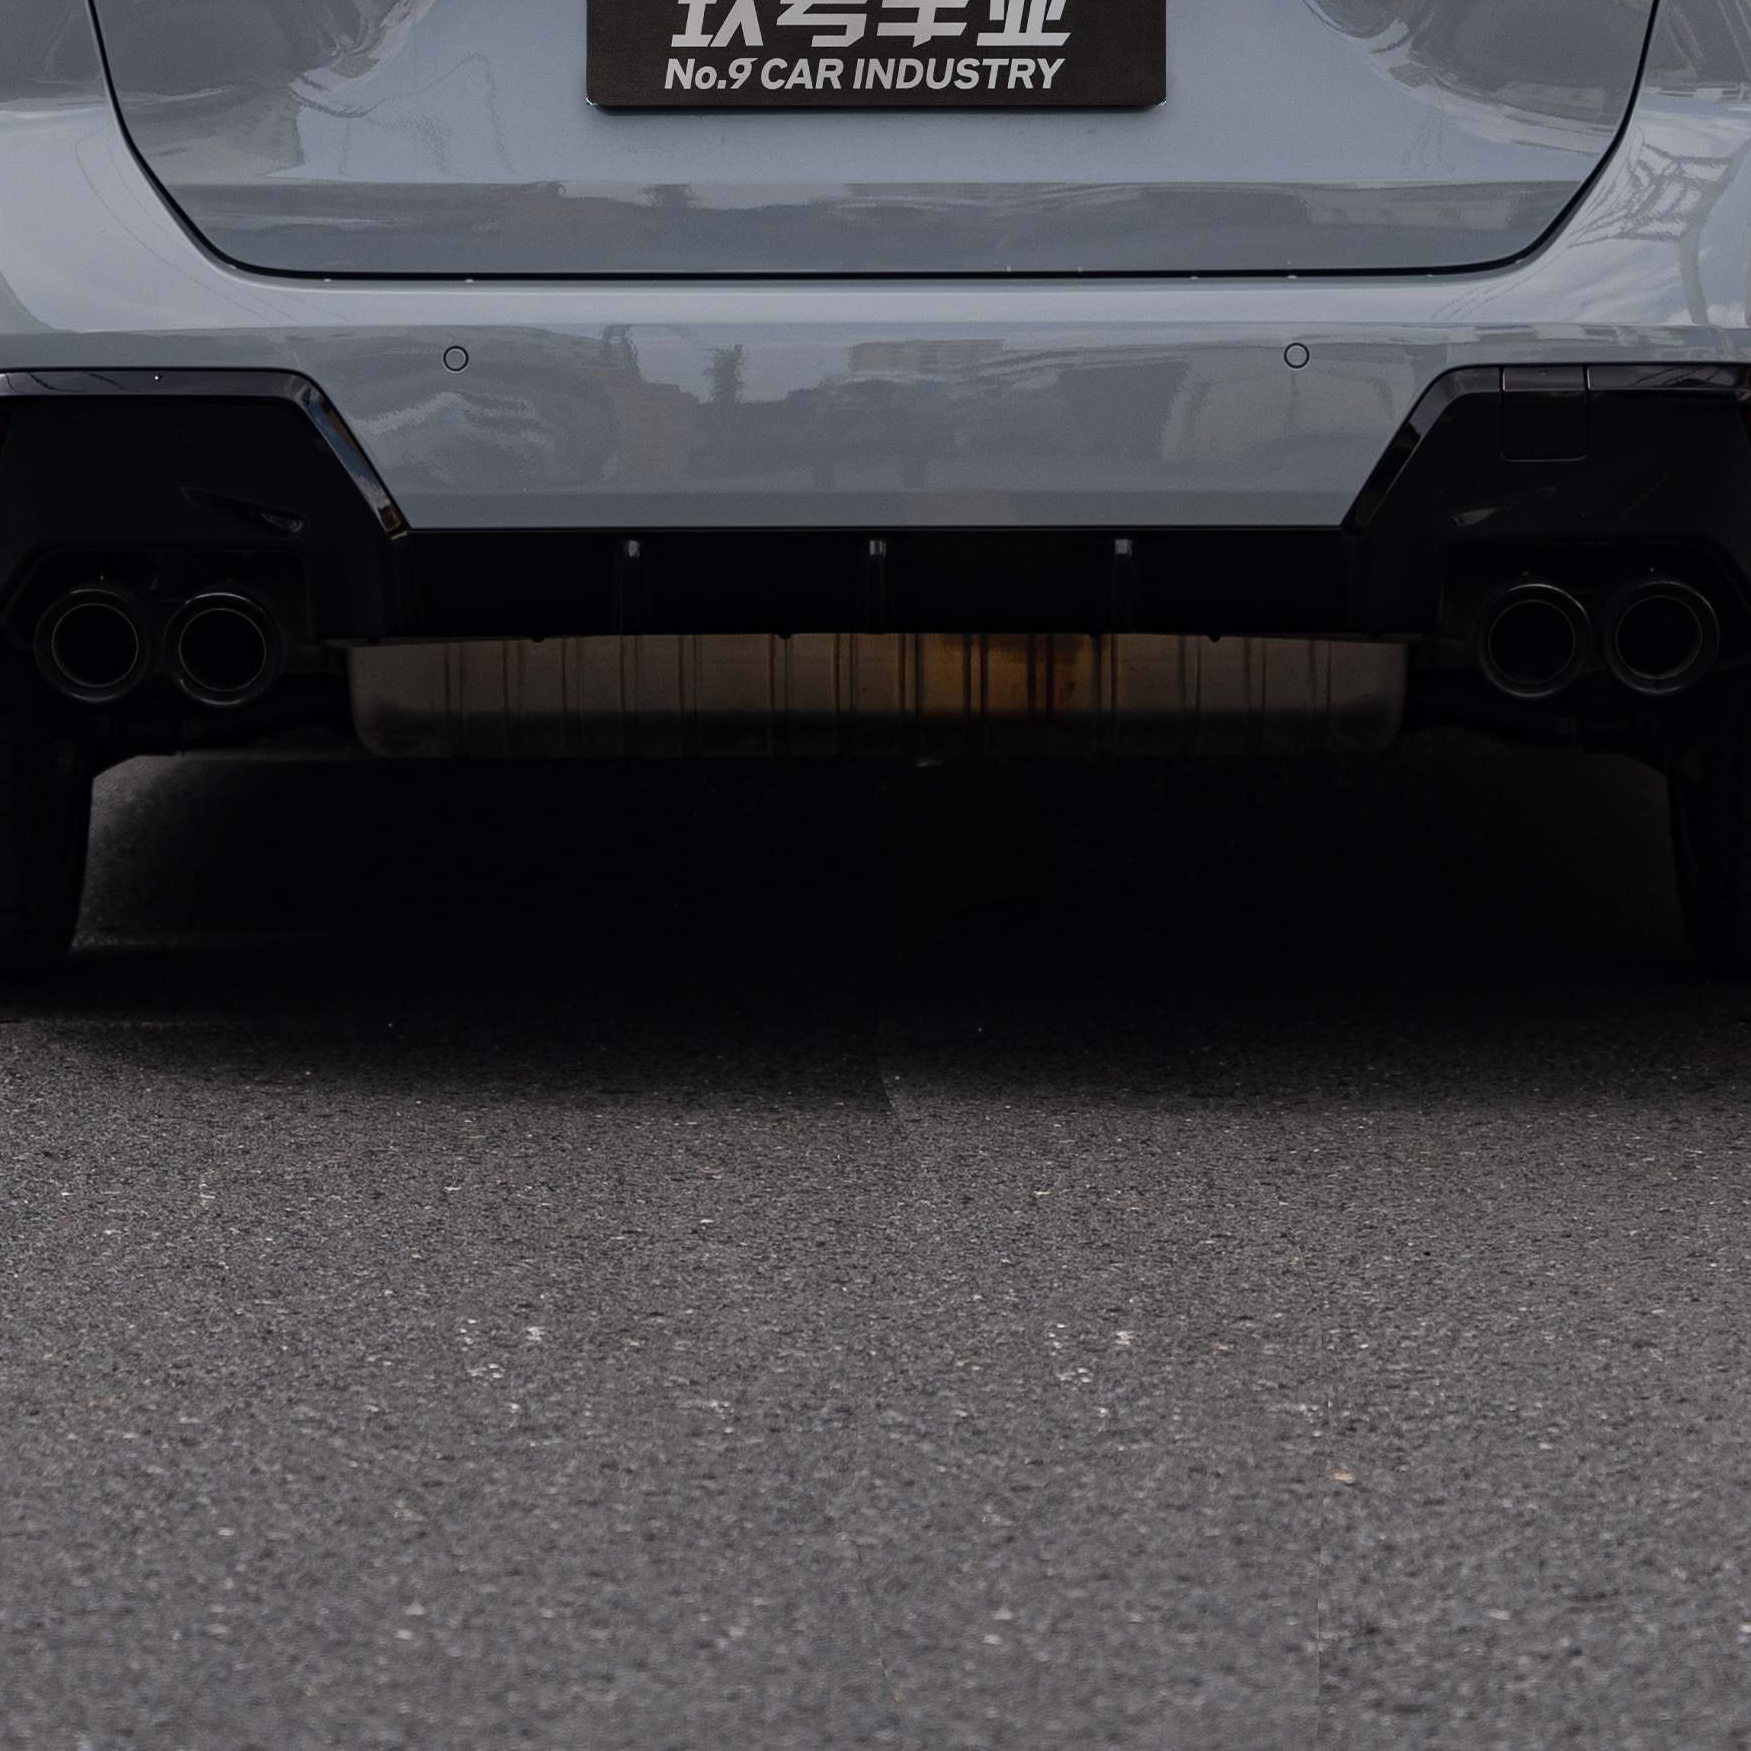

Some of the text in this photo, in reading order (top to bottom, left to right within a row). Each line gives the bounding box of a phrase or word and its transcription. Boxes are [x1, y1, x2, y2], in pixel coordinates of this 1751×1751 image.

[664, 57, 1066, 90] No.9 CAR INDUSTRY
